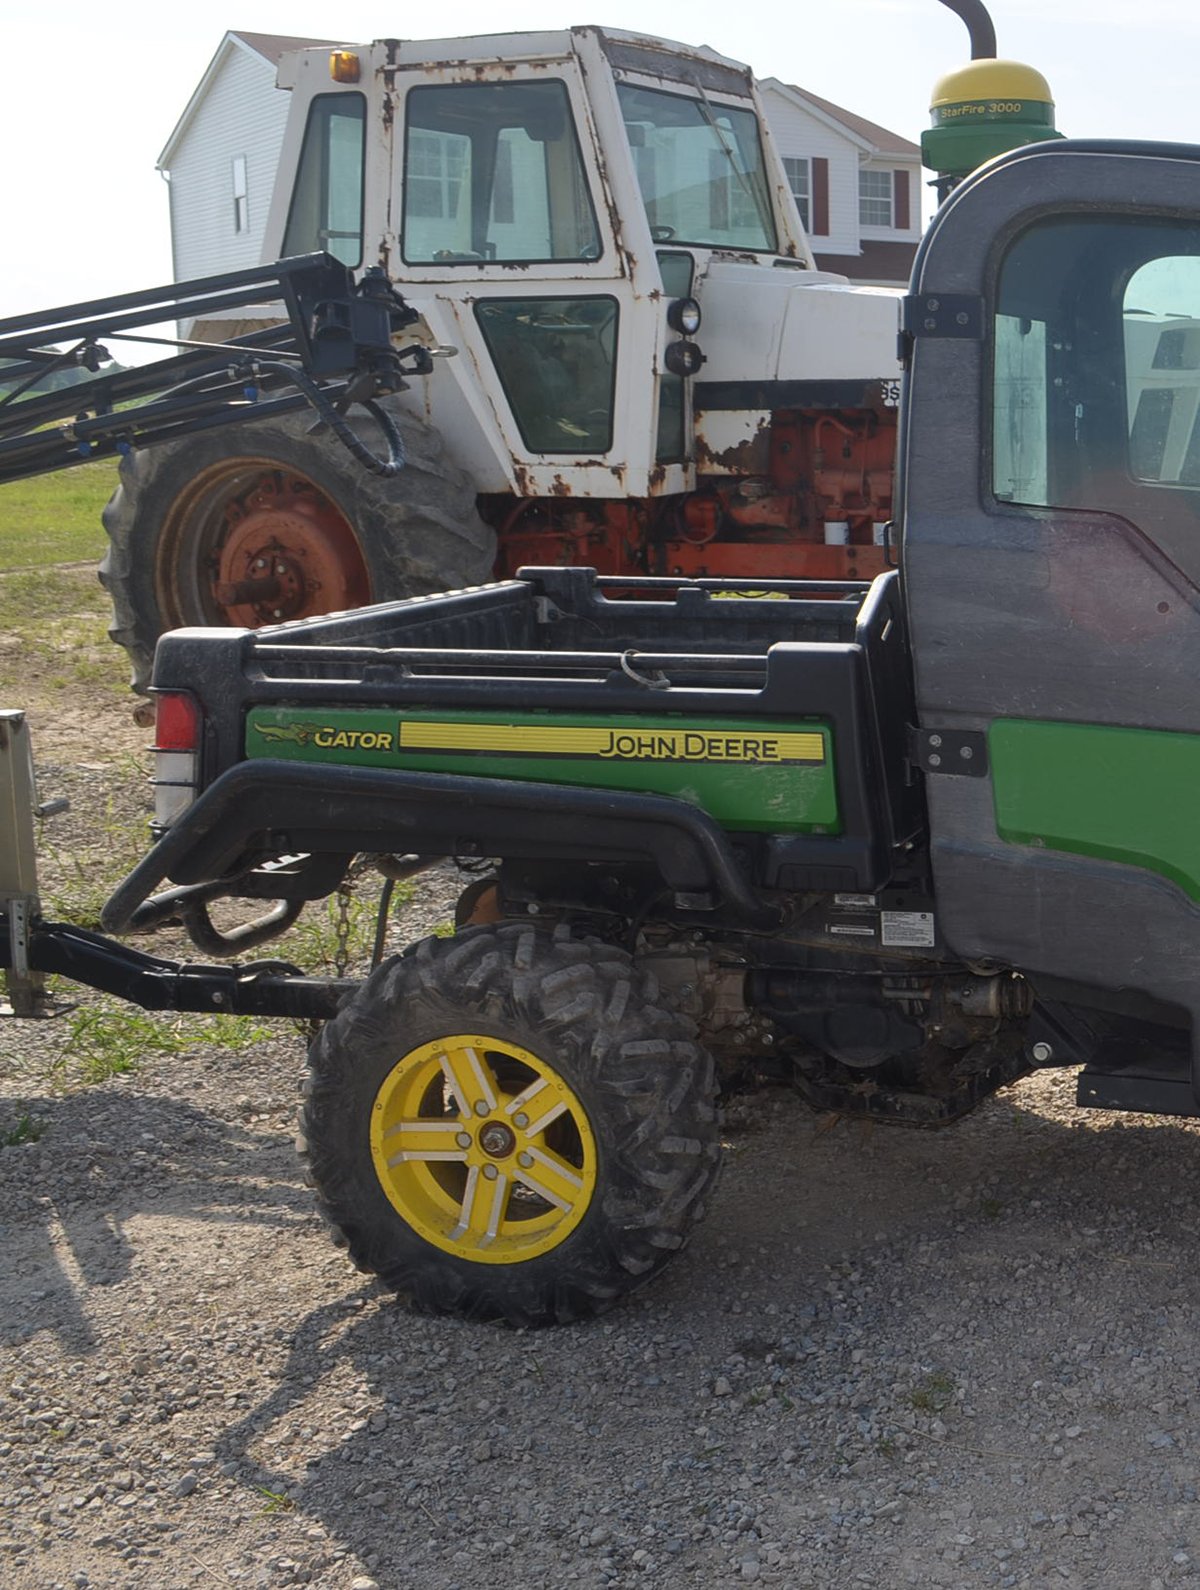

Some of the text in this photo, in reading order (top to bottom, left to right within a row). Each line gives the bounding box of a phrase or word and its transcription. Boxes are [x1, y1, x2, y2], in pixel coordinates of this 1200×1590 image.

[942, 103, 1021, 118] StarFire 3000
[314, 727, 778, 758] GATOR JOHN DEERE
